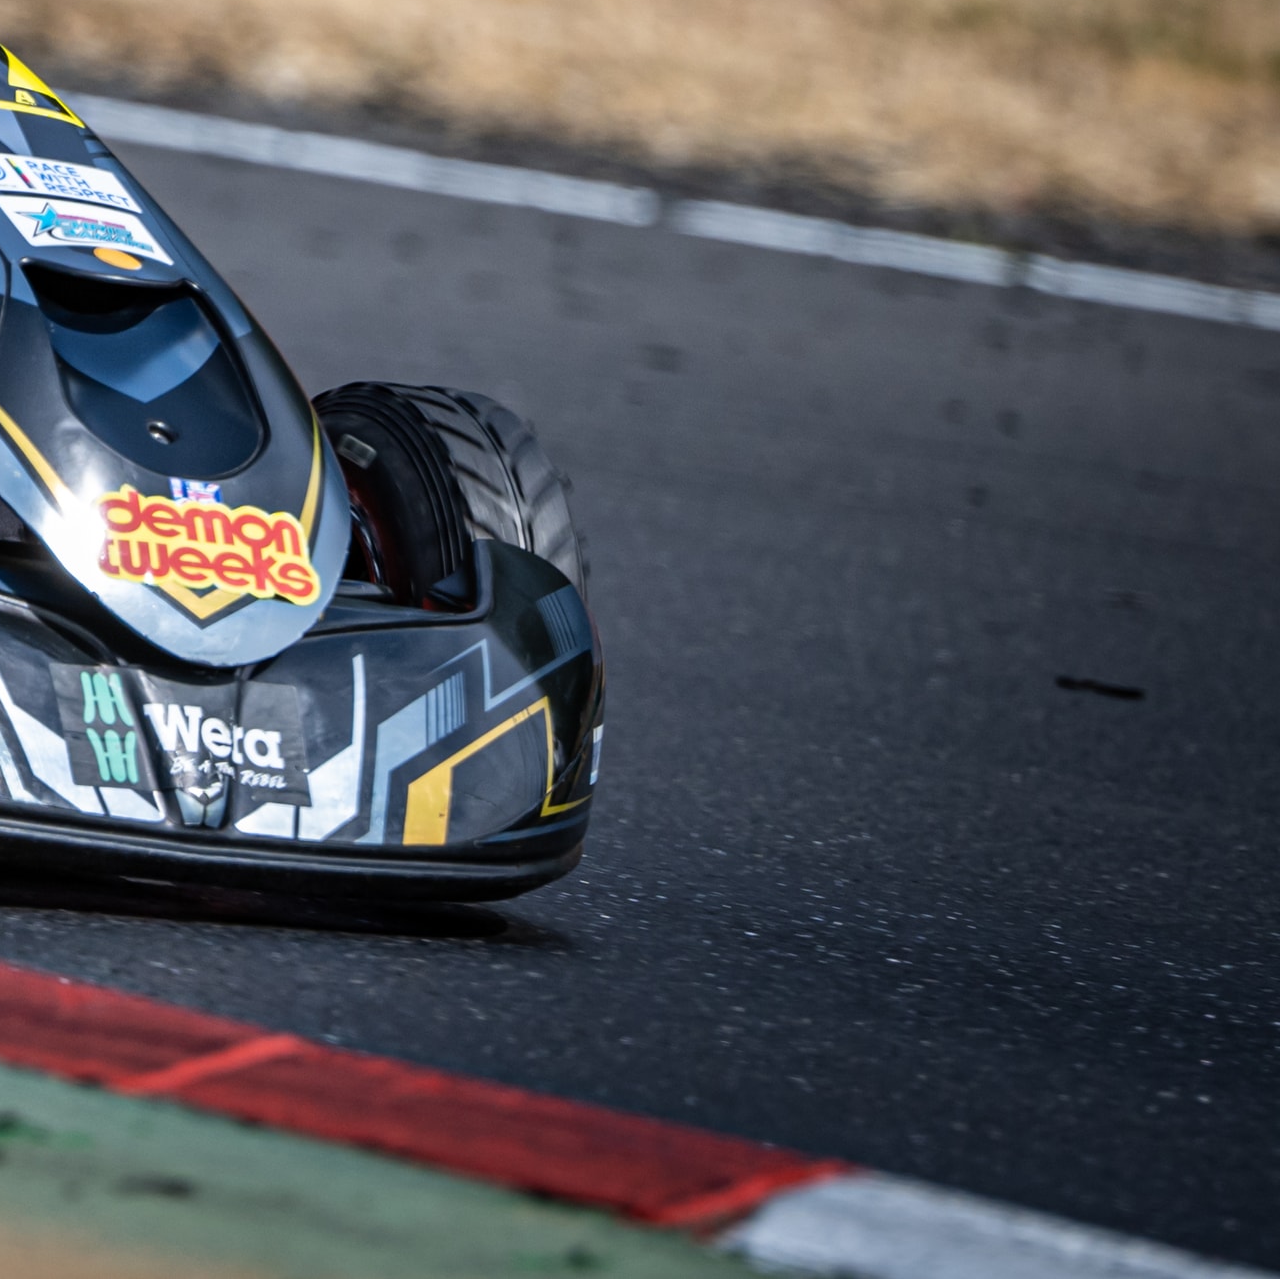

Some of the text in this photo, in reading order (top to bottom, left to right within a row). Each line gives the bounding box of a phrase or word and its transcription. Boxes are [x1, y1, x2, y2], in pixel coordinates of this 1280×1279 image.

[25, 160, 81, 177] RACE
[36, 172, 91, 189] WITH
[45, 182, 130, 207] RESPECT
[99, 491, 302, 557] demon
[98, 537, 314, 598] tweeks
[143, 704, 285, 769] Wera
[239, 770, 288, 790] REBEL
